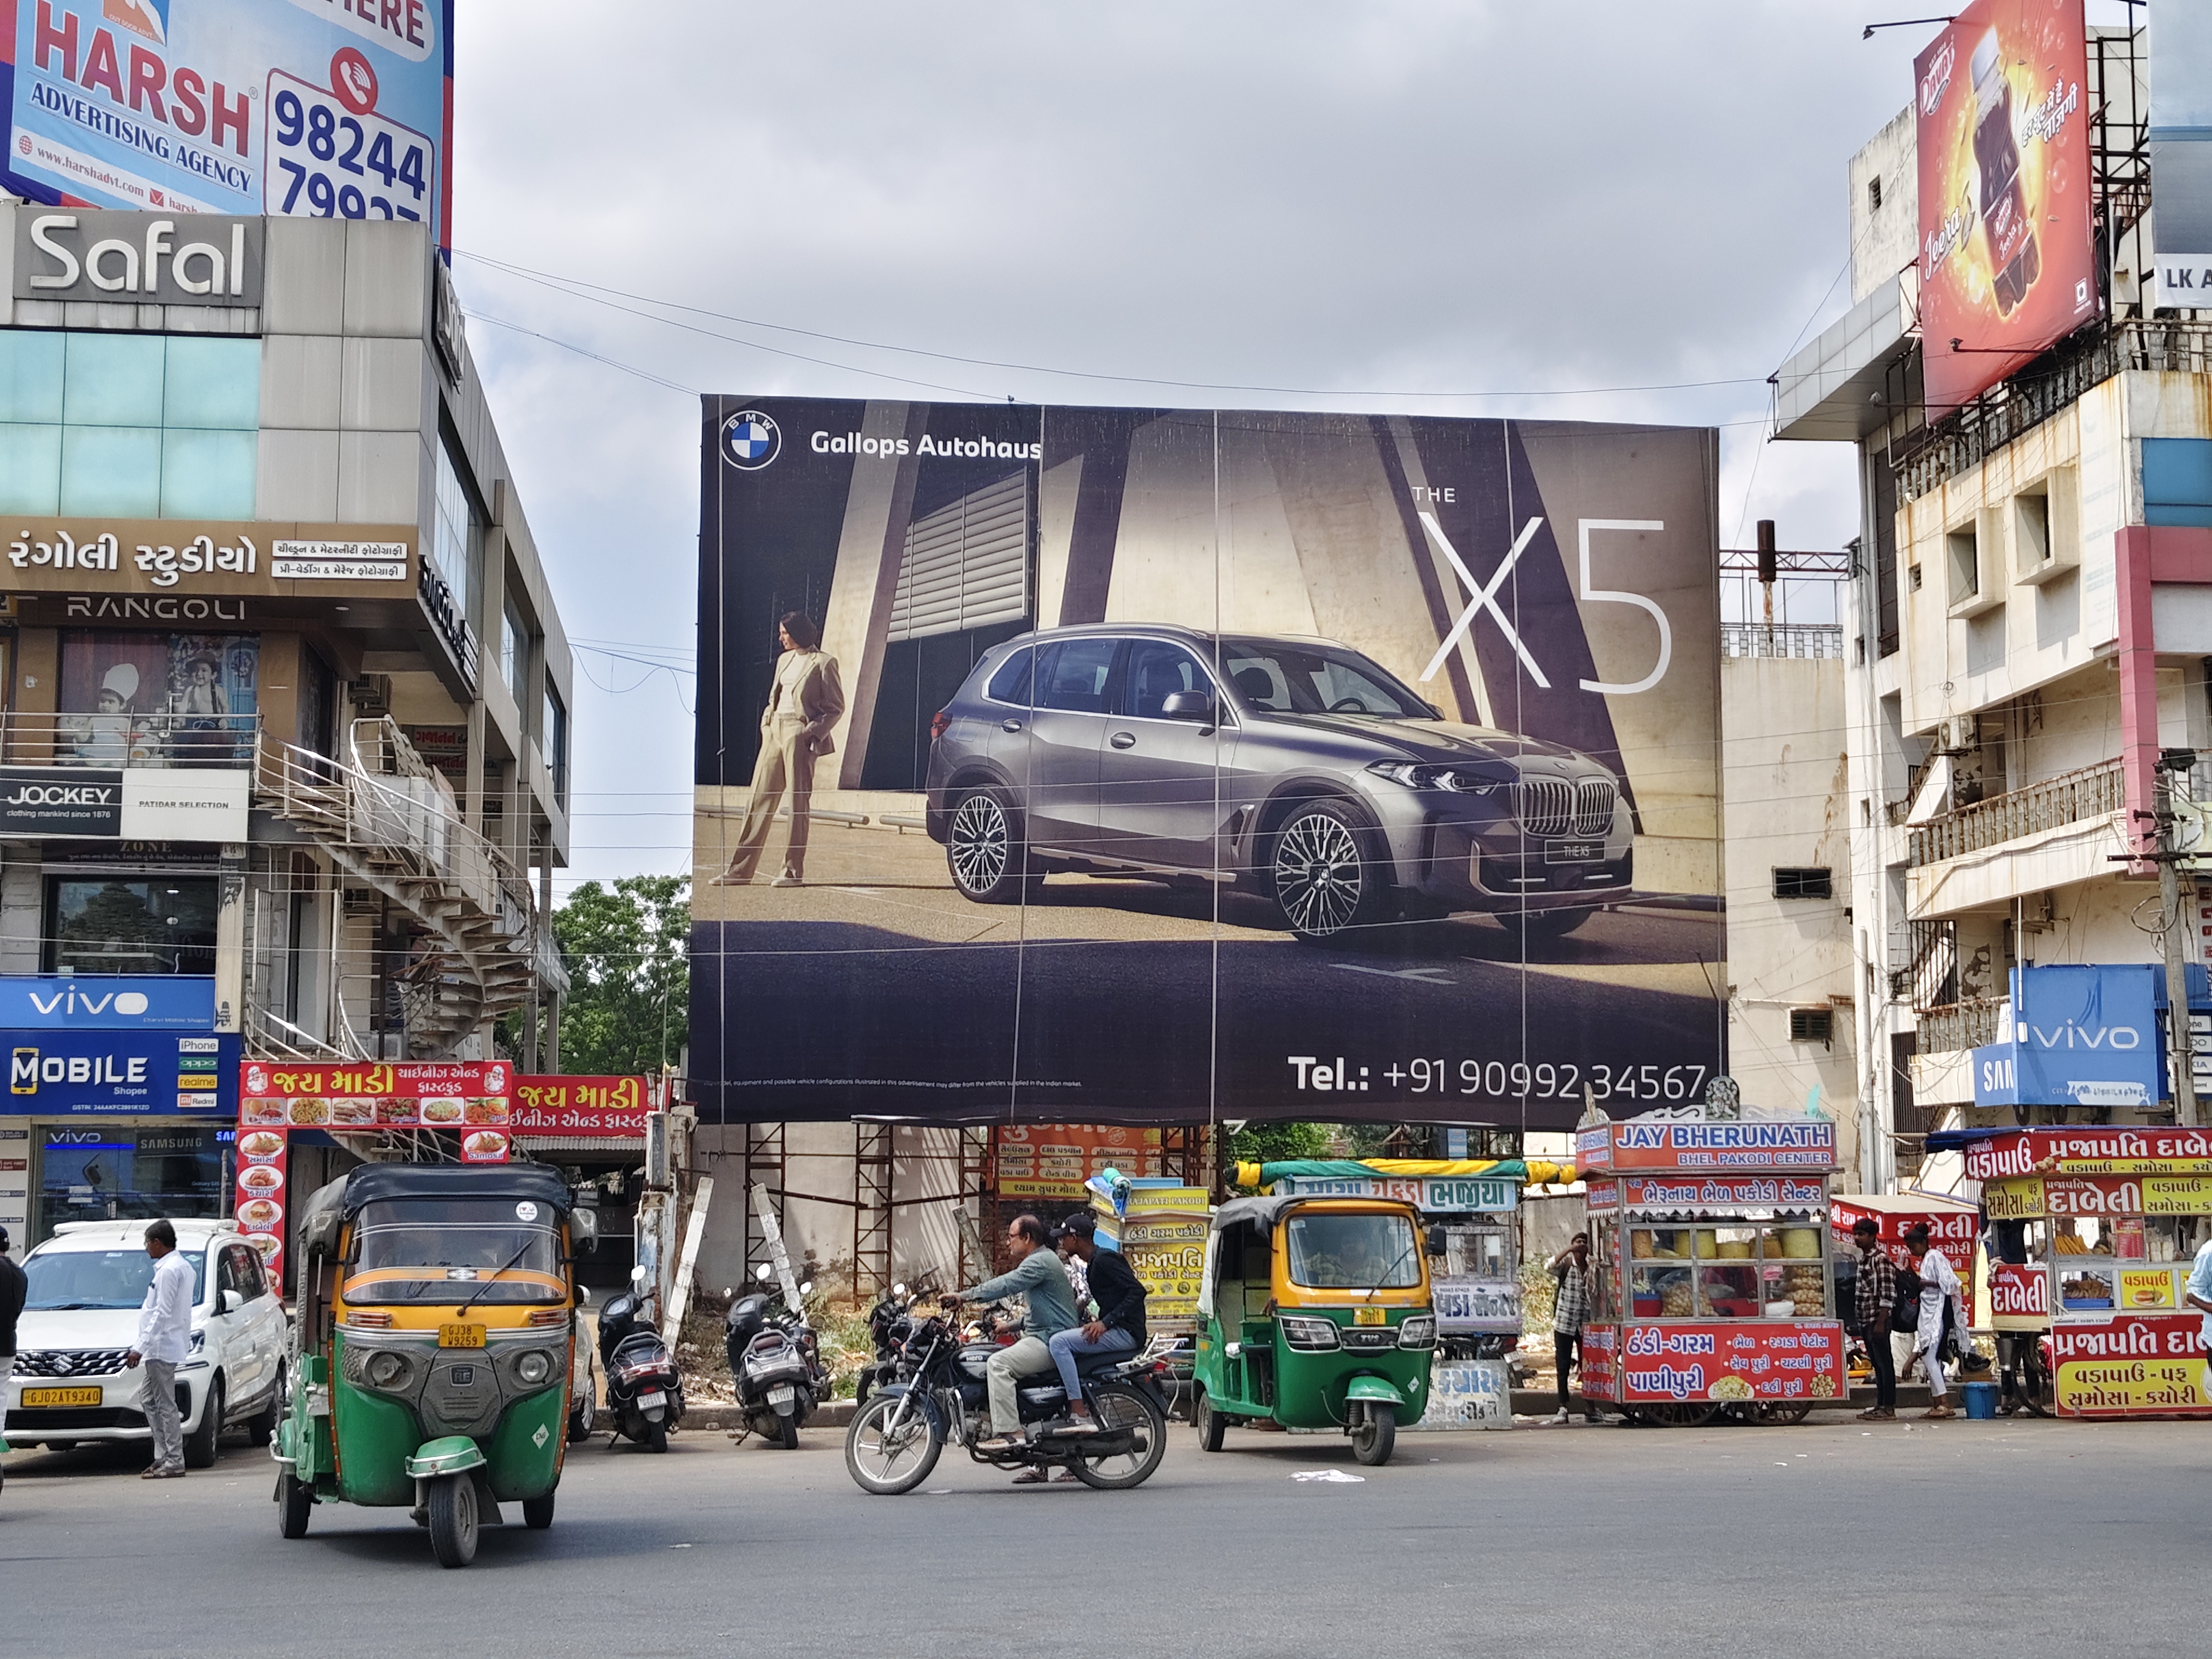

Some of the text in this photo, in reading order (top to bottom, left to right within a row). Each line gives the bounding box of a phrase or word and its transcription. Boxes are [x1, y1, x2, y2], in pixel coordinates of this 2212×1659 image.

[35, 0, 249, 158] HARSH
[31, 82, 251, 192] ADVERTISING AGENCY
[275, 90, 426, 200] 98244
[37, 147, 144, 197] www.harshadvt.com
[1925, 206, 1962, 281] Jeera
[30, 215, 245, 296] Safal
[2167, 268, 2194, 288] LK
[728, 413, 774, 430] BMW
[811, 430, 1042, 460] Gallops Autohaus
[1412, 487, 1456, 503] THE
[8, 530, 257, 586] રંગોલી સ્ટુડીયો
[68, 597, 245, 620] RANGOLI
[1418, 511, 1671, 694] X5
[8, 786, 112, 805] JOCKEY
[119, 841, 172, 853] ZONE
[29, 984, 149, 1014] vivo
[2032, 1018, 2139, 1048] vivo
[181, 1040, 216, 1050] iPhone
[11, 1054, 149, 1085] MOBILE
[180, 1060, 216, 1068] oppo
[180, 1077, 215, 1087] realme
[273, 1065, 394, 1095] જય માડી
[1288, 1056, 1706, 1100] Tel.: +91 90992 34567
[114, 1087, 148, 1096] Shopee
[192, 1097, 214, 1105] Redmi
[517, 1078, 638, 1109] જય માડી
[50, 1129, 102, 1143] vivo
[141, 1137, 203, 1149] SAMSUNG
[1617, 1124, 1667, 1148] JAY
[1672, 1124, 1830, 1148] BHERUNATH
[2049, 1131, 2212, 1158] પ્રજાપતિ દાબે
[248, 1155, 275, 1164] સમોસા
[468, 1151, 504, 1160] Samosa
[1678, 1152, 1831, 1166] BHEL PAKODI CENTER
[2132, 1159, 2173, 1172] સમોસા
[1128, 1197, 1206, 1205] RAJAPATI PAKODI
[1429, 1182, 1505, 1208] ભજીયા
[1701, 1180, 1731, 1203] ભેળ
[1735, 1179, 1778, 1203] પકોડી
[1782, 1180, 1823, 1202] સેન્ટર
[1987, 1185, 2024, 1217] સમોસા
[2048, 1182, 2142, 1213] દાબેલી
[2147, 1197, 2191, 1212] સમોસા
[1842, 1210, 1856, 1225] રામ
[1897, 1213, 1973, 1238] દબેલી
[1151, 1228, 1174, 1238] ગરમ
[1132, 1247, 1203, 1268] પ્રજાપતિ
[1993, 1274, 2047, 1312] દાબેલી
[448, 1336, 478, 1345] W9259
[449, 1325, 472, 1335] GJ38
[2055, 1323, 2157, 1356] પ્રજાપતિ
[1732, 1334, 1755, 1348] ભેળ
[1769, 1336, 1797, 1348] રગડા
[1730, 1354, 1833, 1373] સેવ પુરી ચટણી પુરી
[1627, 1363, 1704, 1399] પાણીપુરી
[1784, 1378, 1804, 1397] પુરી
[31, 1391, 99, 1403] GJ02AT9340
[2068, 1385, 2196, 1406] સમોસા કચોરી
